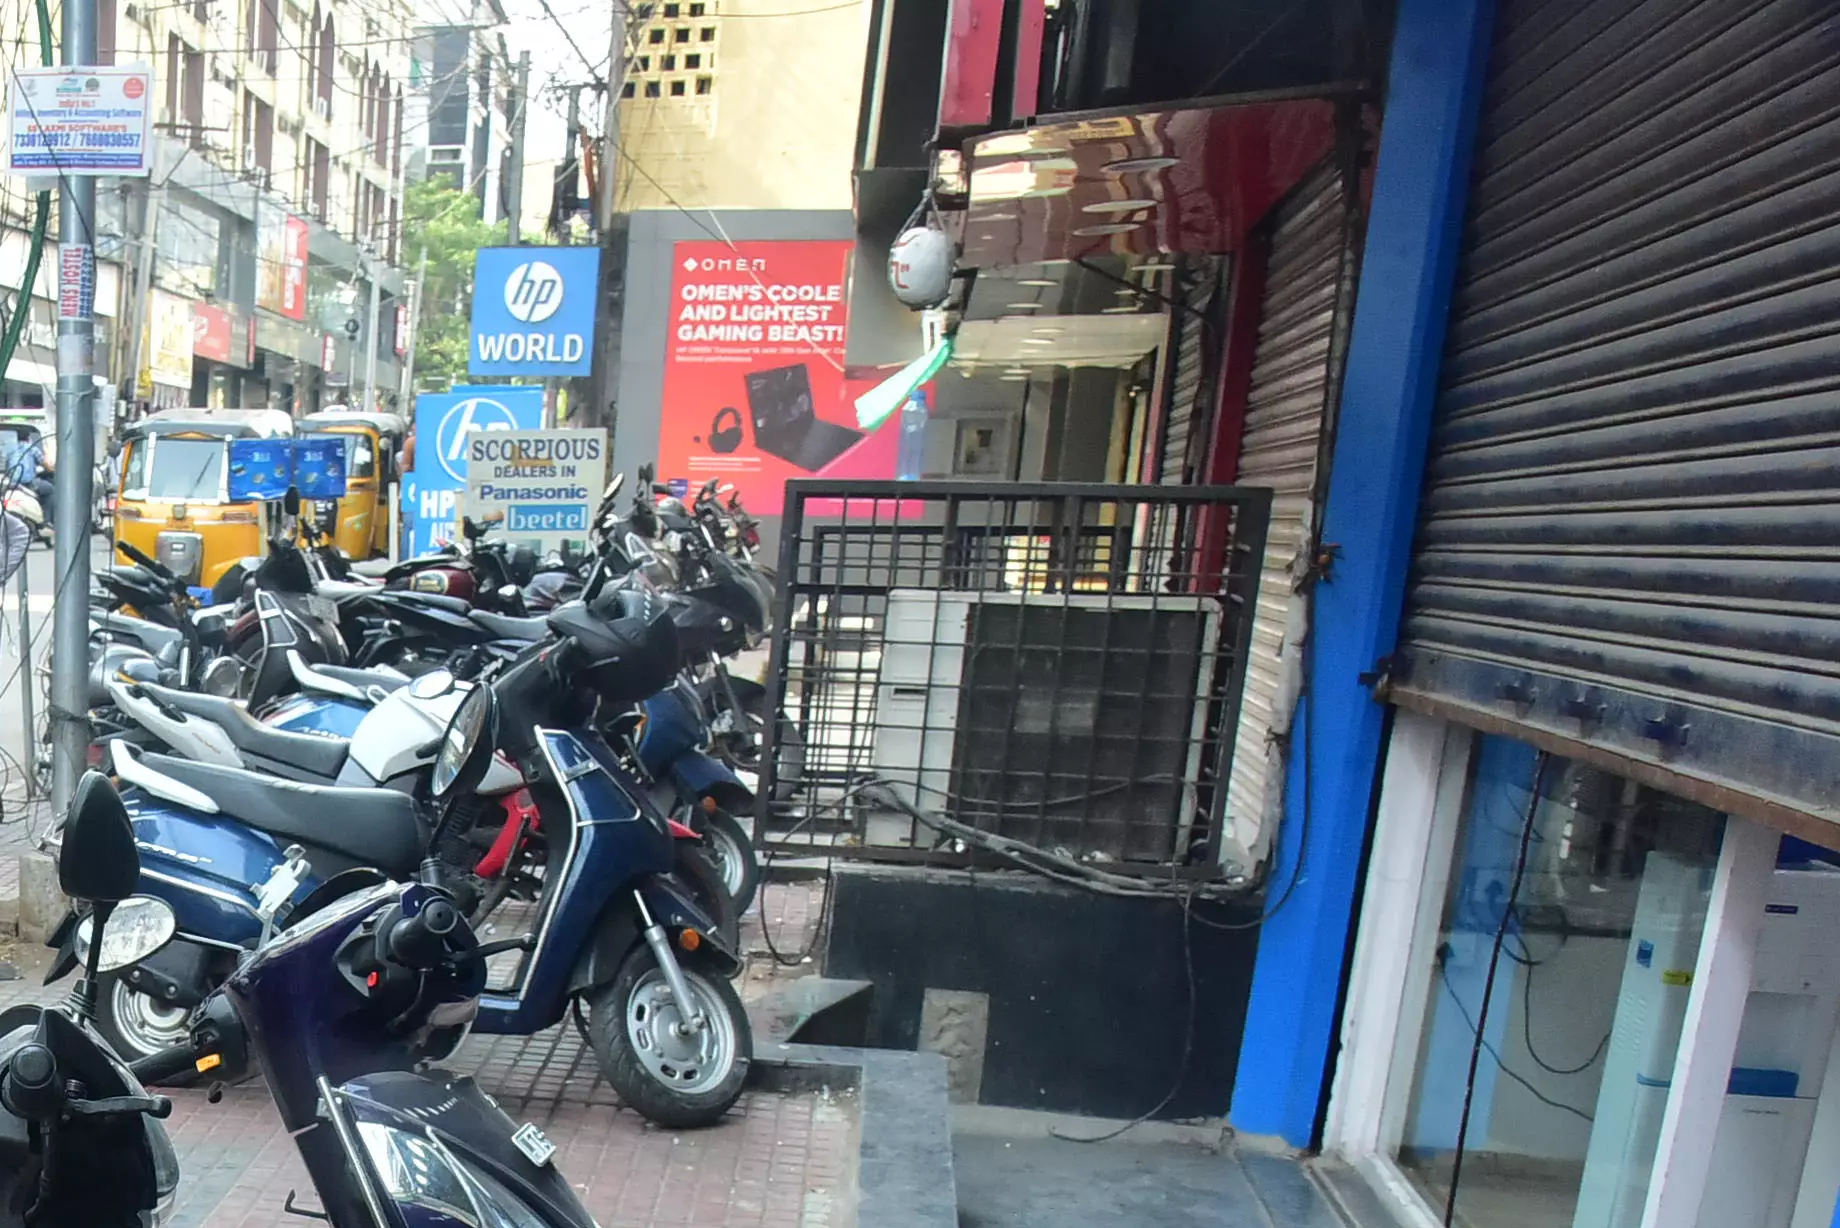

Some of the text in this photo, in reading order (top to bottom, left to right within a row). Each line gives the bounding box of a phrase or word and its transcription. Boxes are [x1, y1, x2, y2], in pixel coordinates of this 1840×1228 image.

[61, 247, 81, 318] MENS HOSTEL
[511, 262, 558, 322] hp
[681, 284, 760, 302] OMEN'S
[678, 305, 833, 322] AND LIGHTEST
[677, 325, 845, 342] GAMING BEAST!
[477, 332, 584, 363] WORLD
[472, 438, 600, 461] SCORPIOUS
[494, 465, 576, 478] DEALERS IN
[480, 483, 588, 500] Panasonic
[510, 505, 587, 530] beetel
